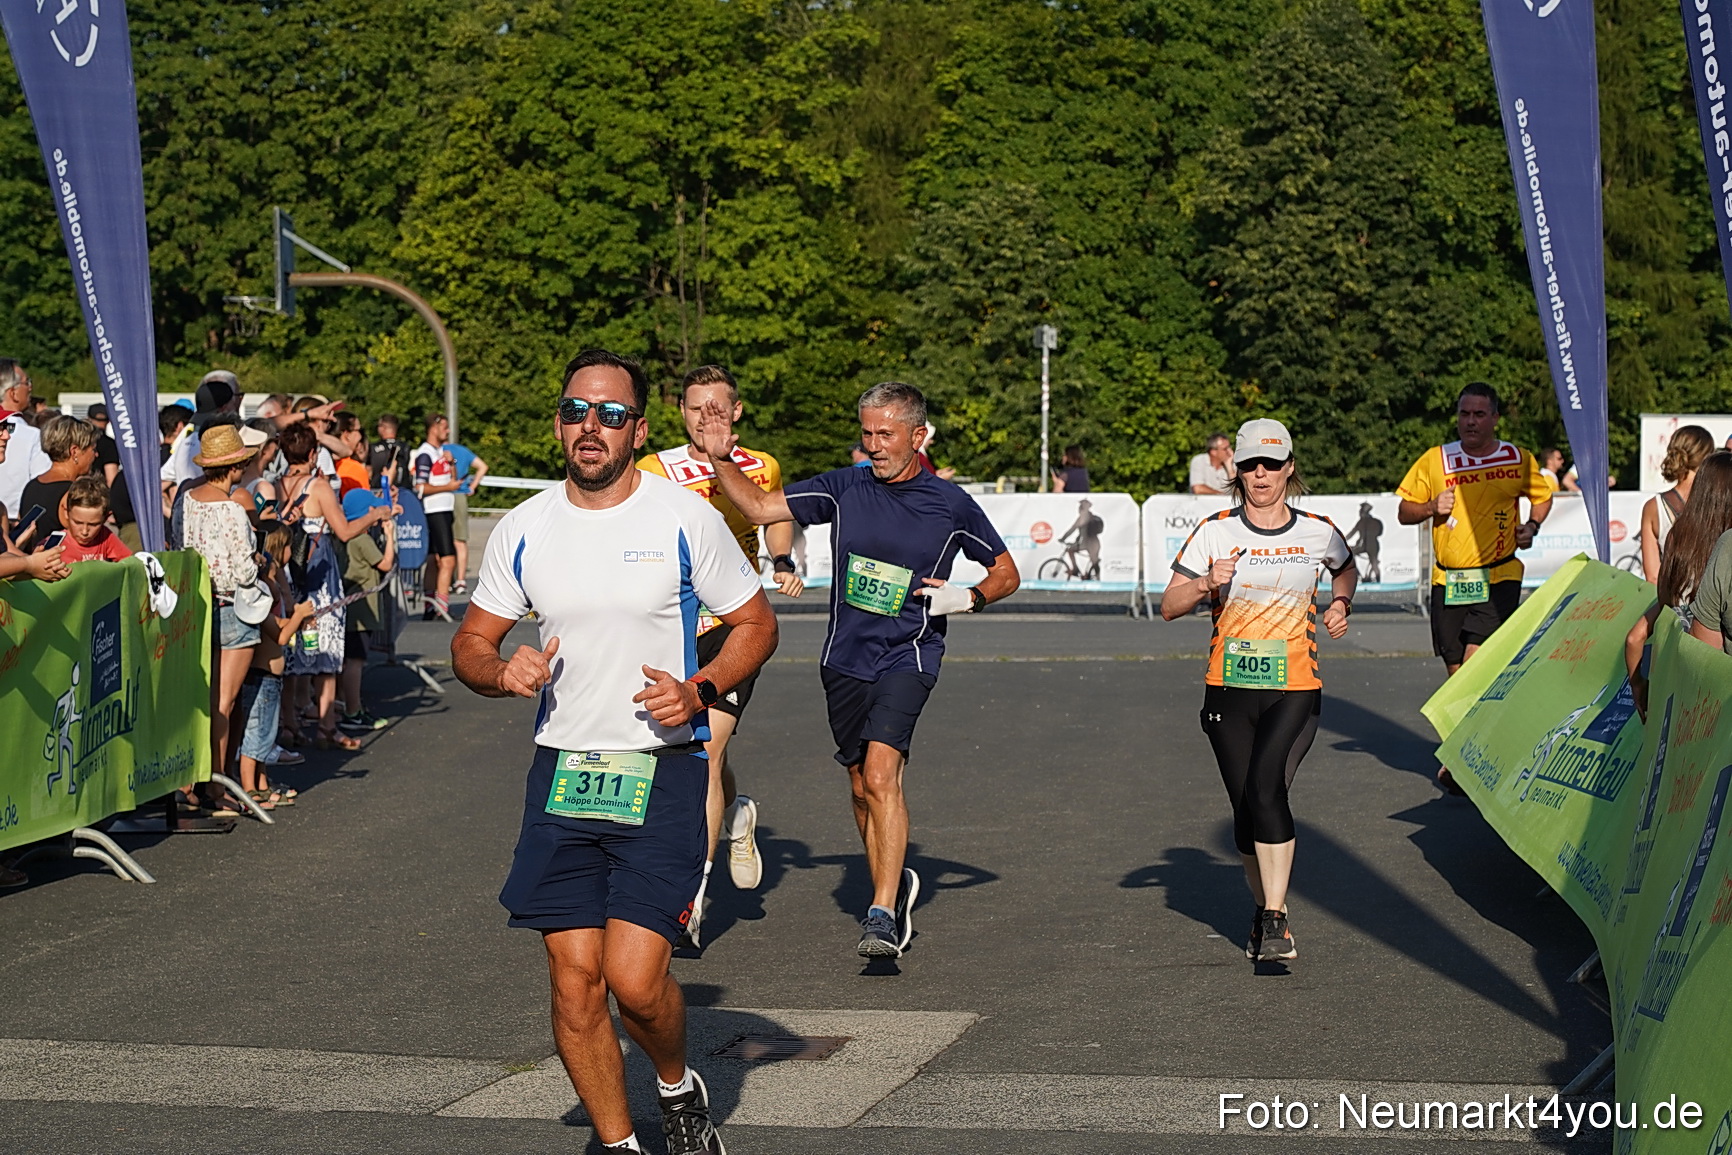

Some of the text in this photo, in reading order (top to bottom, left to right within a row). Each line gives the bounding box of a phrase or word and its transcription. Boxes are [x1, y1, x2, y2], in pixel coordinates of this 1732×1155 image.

[1445, 467, 1521, 488] MAX BÖGL
[1165, 516, 1199, 529] NOW
[1251, 547, 1309, 556] KLEBL
[1249, 556, 1310, 566] DYNAMICS
[857, 575, 891, 598] 955
[1454, 581, 1483, 593] 1588
[874, 597, 892, 606] Josef
[891, 588, 905, 611] 2022
[1236, 656, 1271, 673] 405
[1277, 659, 1285, 682] 2022
[1236, 672, 1260, 680] Thomas
[554, 778, 568, 802] RUN
[575, 770, 624, 797] 311
[564, 795, 632, 809] Höppe Dominik
[631, 781, 647, 814] 2022
